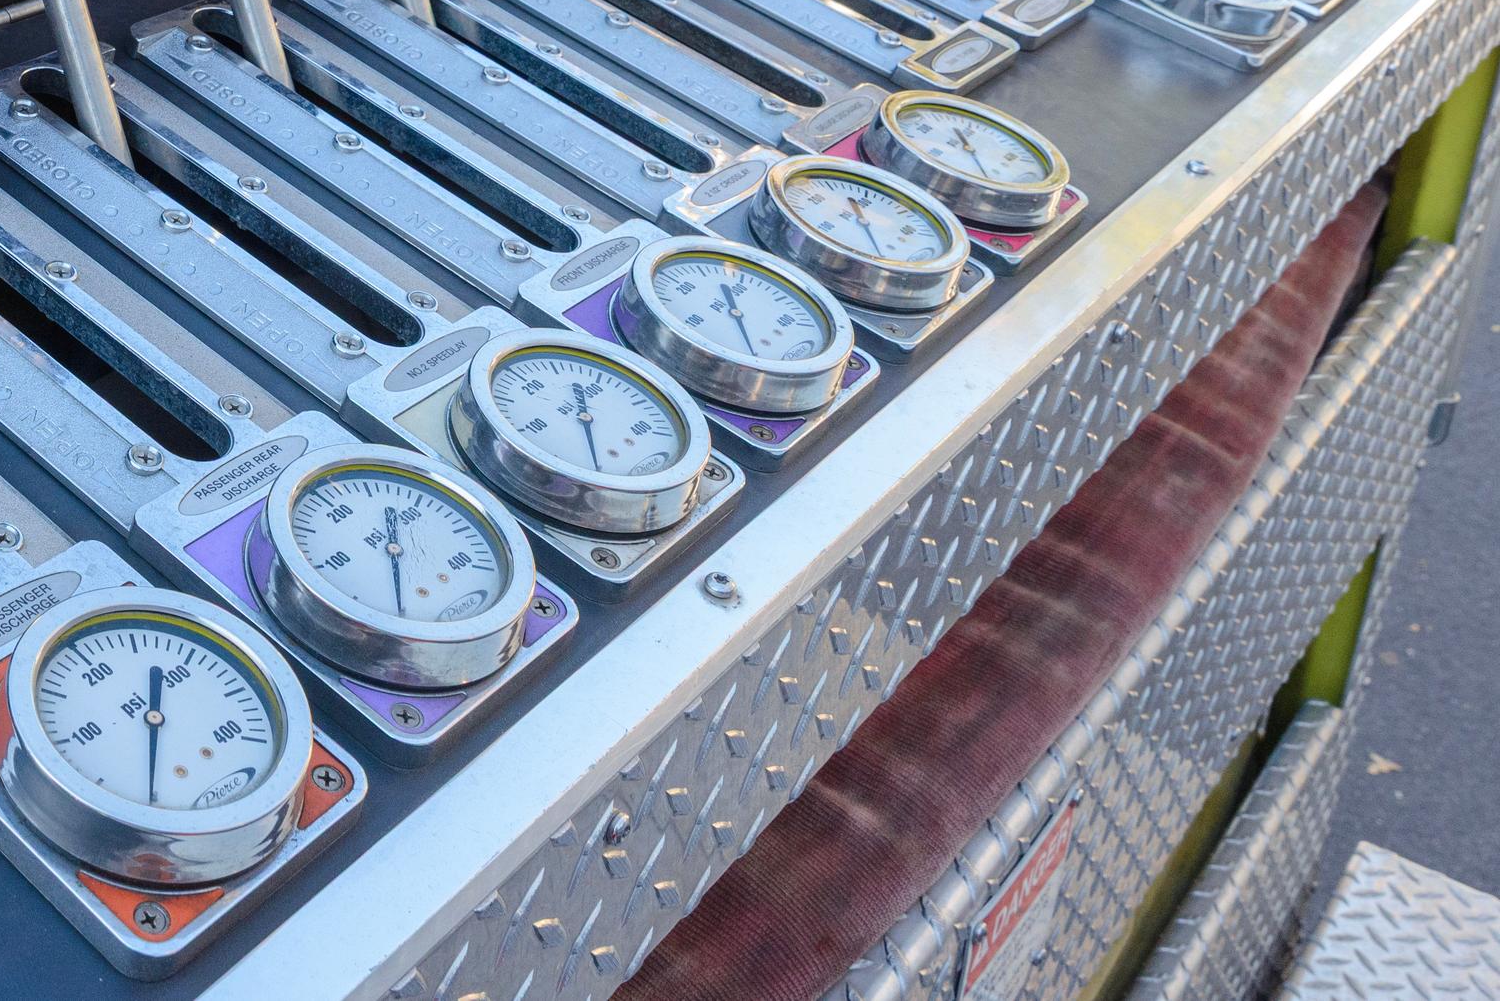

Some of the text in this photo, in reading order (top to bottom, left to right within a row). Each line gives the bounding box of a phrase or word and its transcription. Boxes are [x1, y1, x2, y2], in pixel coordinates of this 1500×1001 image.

[346, 9, 423, 60] CLOSED
[190, 68, 272, 126] CLOSED
[12, 137, 96, 199] CLOSED
[554, 134, 619, 180] OPEN
[720, 168, 750, 188] CROSSLAY
[404, 209, 475, 260] OPEN
[557, 239, 630, 287] FRONT DISCHARGE
[675, 281, 696, 296] 200
[709, 298, 726, 313] psi
[231, 299, 304, 354] OPEN
[685, 314, 706, 329] 100
[775, 313, 796, 329] 400
[426, 339, 468, 367] SPEEDLAY
[521, 380, 545, 396] 200
[585, 383, 605, 401] 300
[556, 401, 576, 417] psi
[21, 407, 97, 472] OPEN
[524, 418, 549, 435] 100
[629, 420, 653, 438] 400
[193, 443, 284, 502] PASSENGER REAR
[633, 454, 662, 476] Pierce
[221, 461, 282, 502] DISCHARGE
[326, 504, 354, 525] 200
[398, 506, 423, 529] 300
[363, 528, 384, 551] psi
[323, 551, 351, 572] 100
[446, 551, 473, 573] 400
[443, 595, 478, 622] Pierce
[81, 661, 115, 688] 200
[161, 663, 192, 690] 300
[119, 691, 149, 721] psi
[71, 720, 102, 747] 100
[211, 718, 244, 745] 400
[202, 775, 242, 809] Pierce
[990, 814, 1071, 946] DANGER
